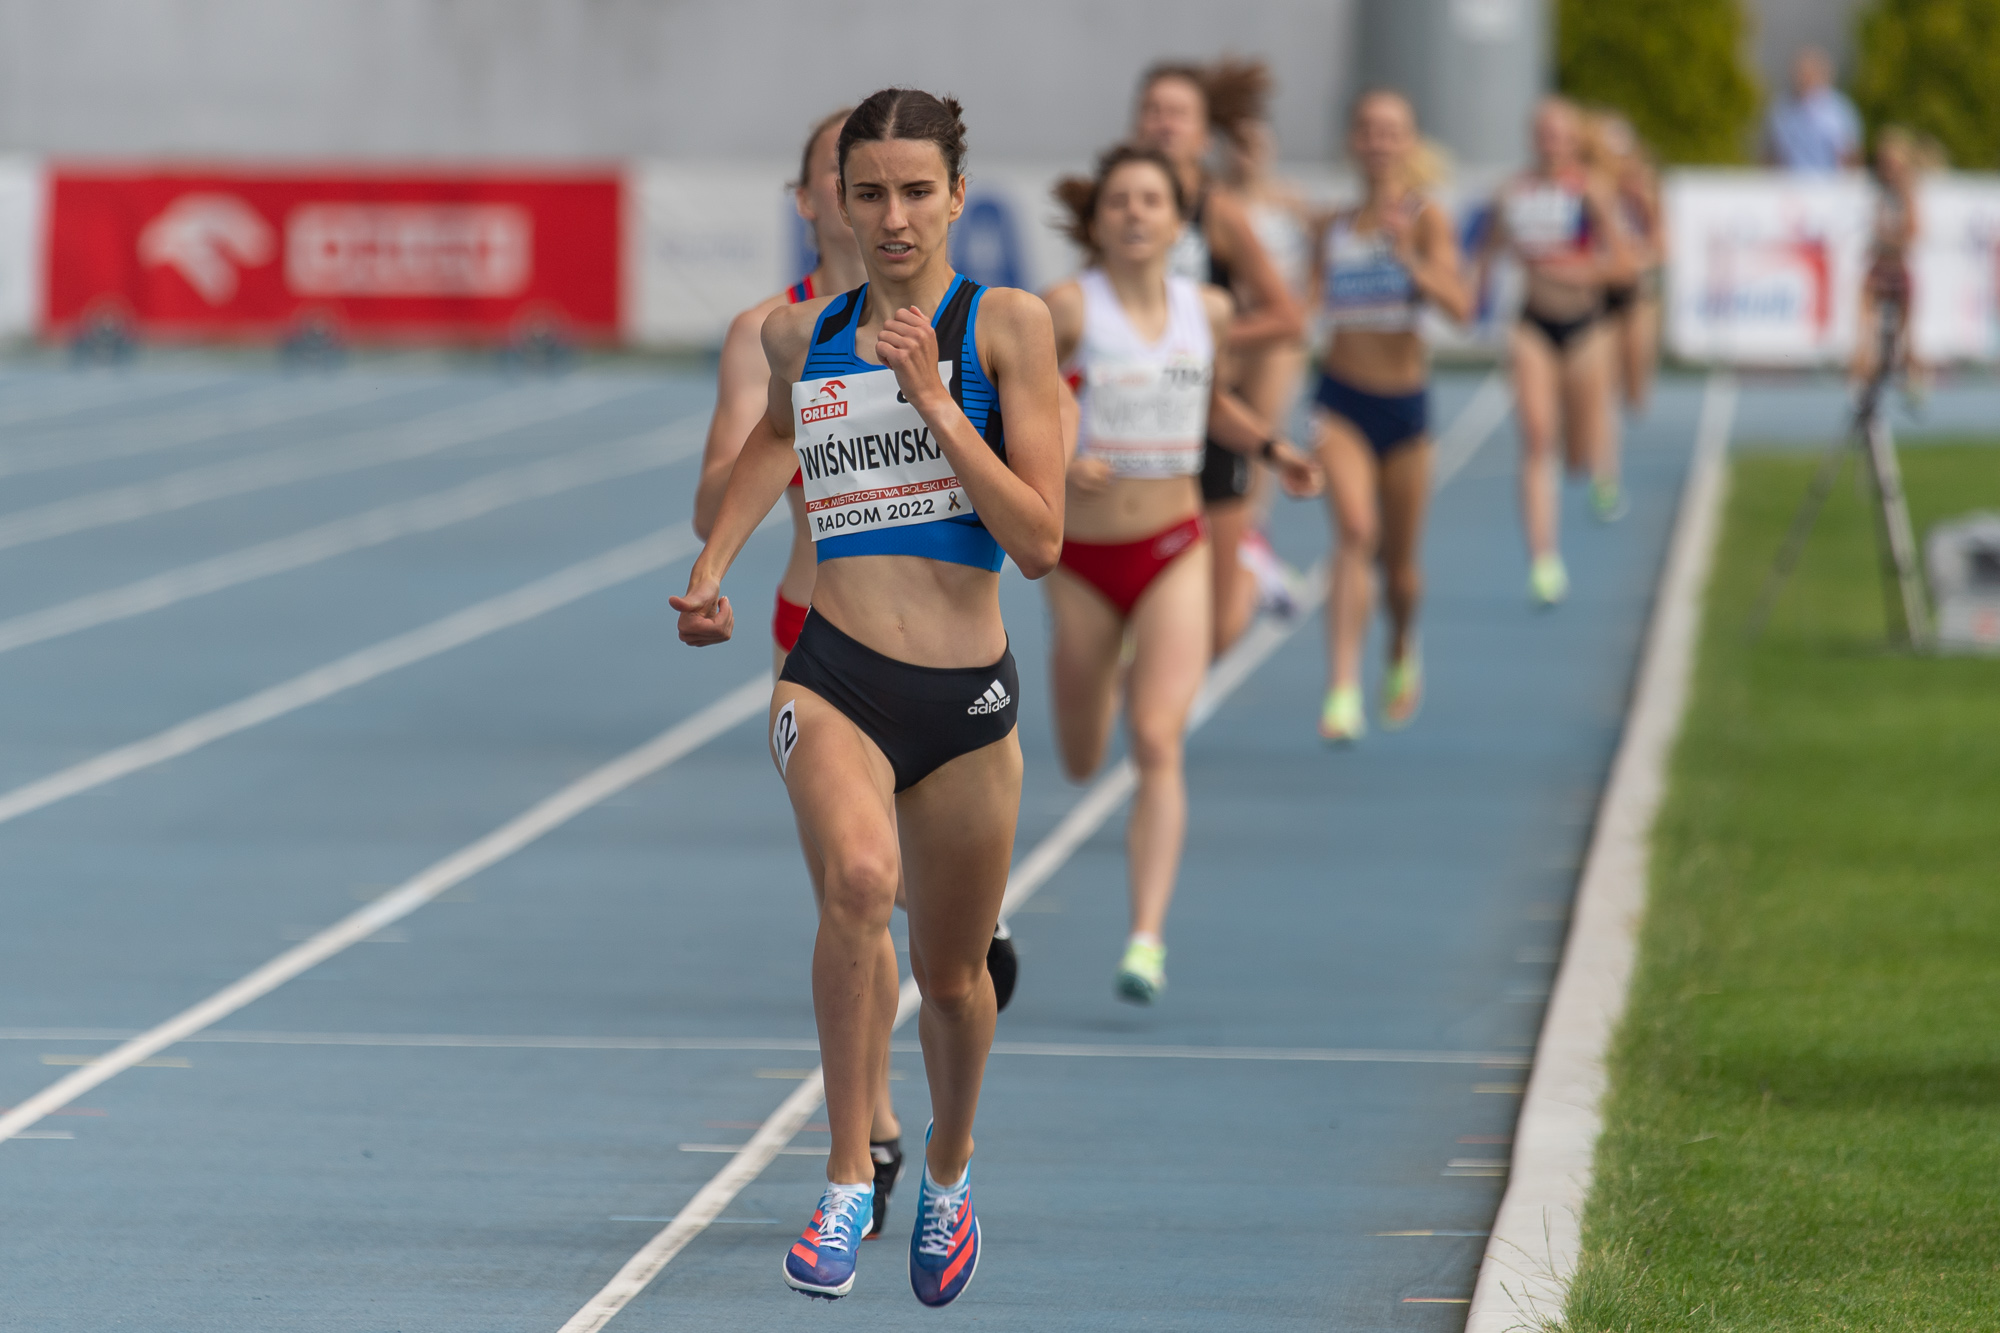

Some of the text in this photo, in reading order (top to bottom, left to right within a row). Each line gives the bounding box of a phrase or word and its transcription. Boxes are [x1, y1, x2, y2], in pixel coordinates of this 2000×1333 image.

[802, 403, 845, 422] ORLEN
[809, 478, 962, 511] PZLA MISTRZOSTWA POLSKI U2
[817, 499, 935, 532] RADOM 2022
[967, 693, 1011, 715] adidas
